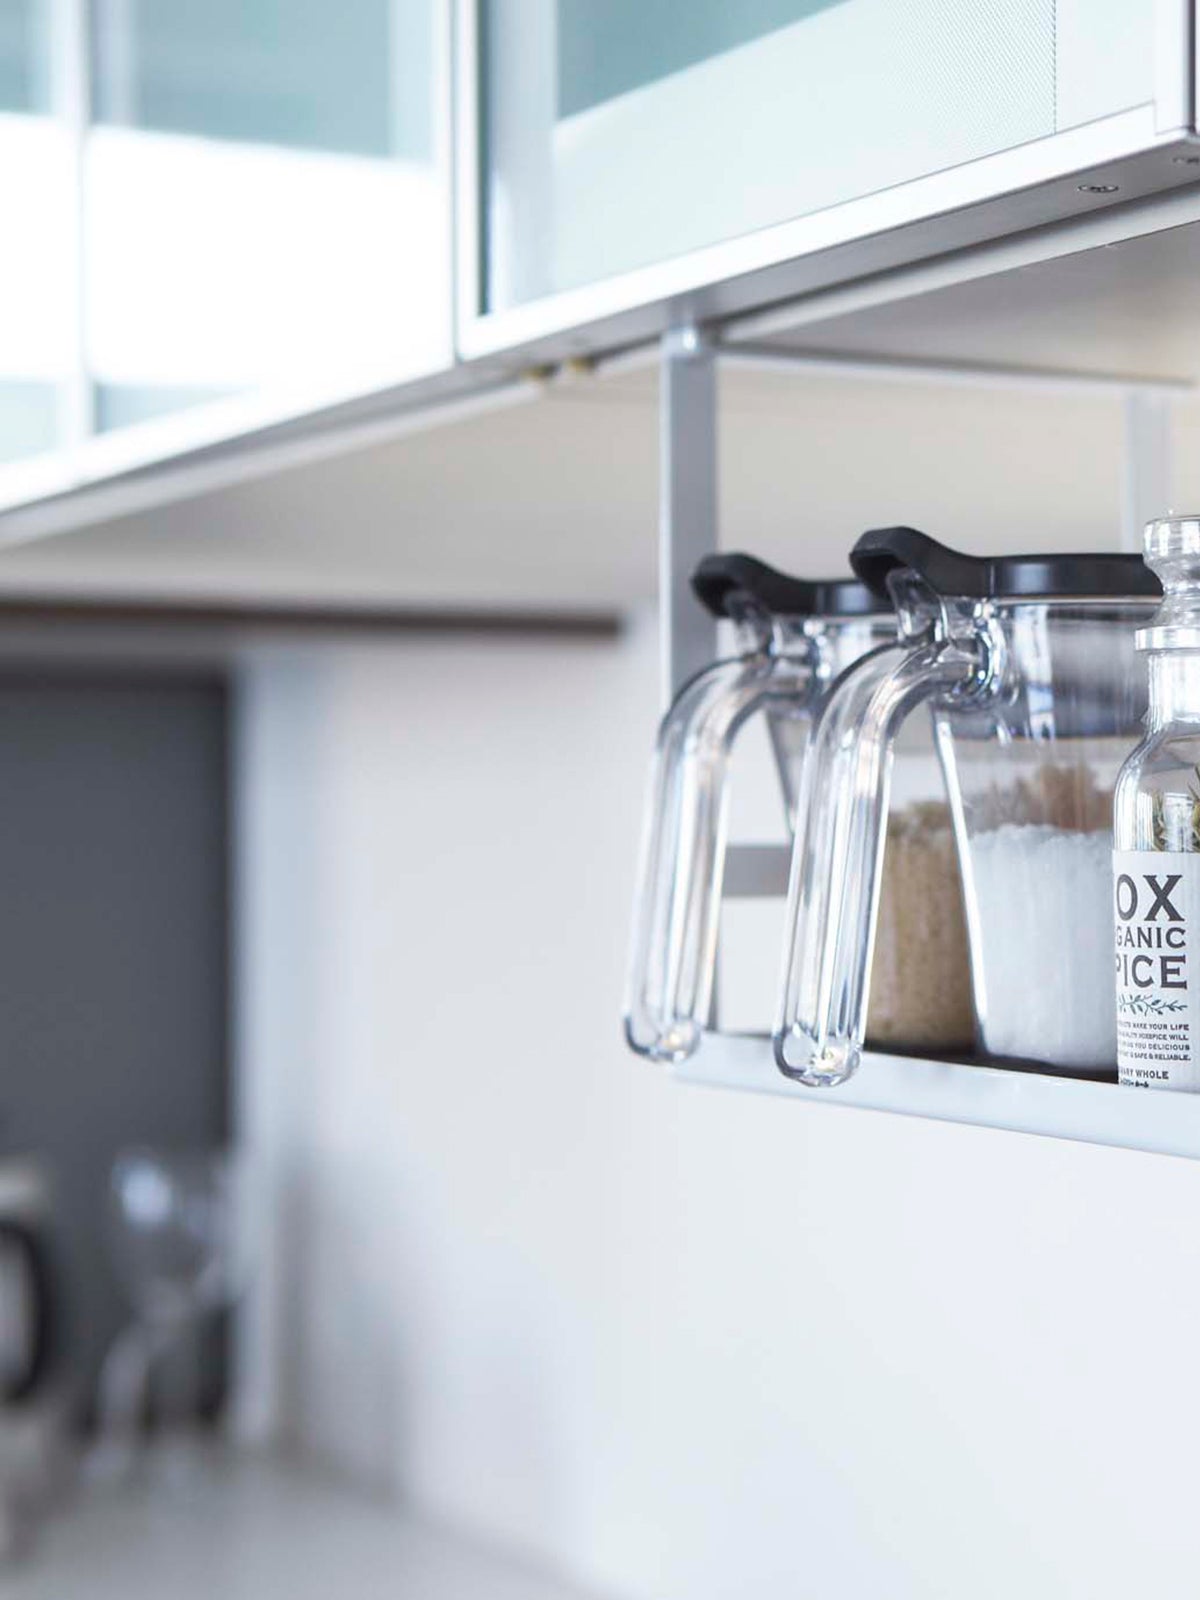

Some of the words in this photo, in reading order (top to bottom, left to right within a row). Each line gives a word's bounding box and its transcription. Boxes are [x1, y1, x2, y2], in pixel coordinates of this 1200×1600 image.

[1116, 873, 1186, 922] OX
[1170, 1023, 1190, 1031] LIFE
[1148, 1043, 1191, 1051] DELICIOUS
[1135, 1069, 1170, 1080] WHOLE
